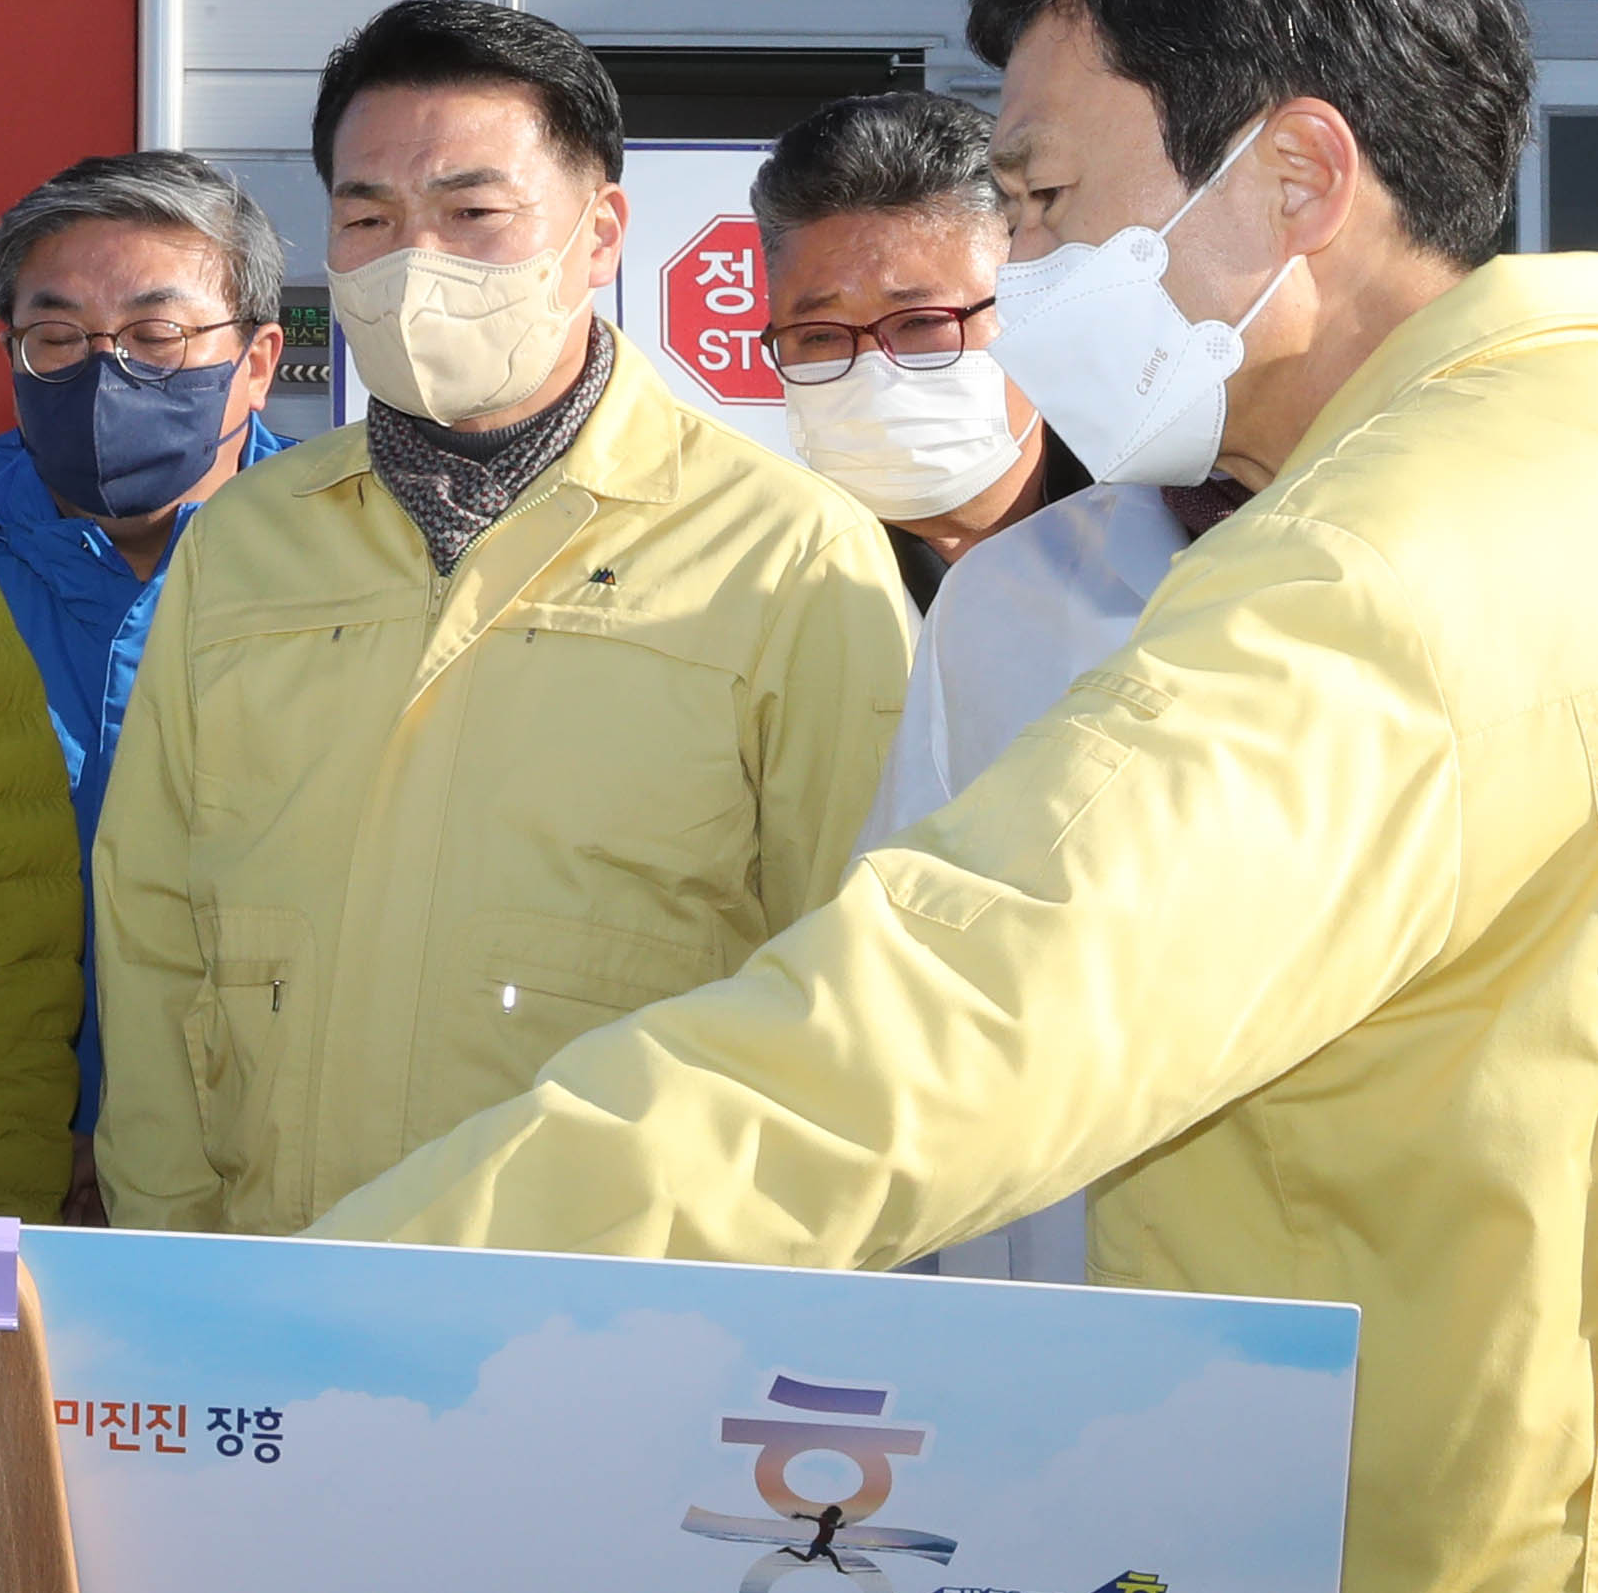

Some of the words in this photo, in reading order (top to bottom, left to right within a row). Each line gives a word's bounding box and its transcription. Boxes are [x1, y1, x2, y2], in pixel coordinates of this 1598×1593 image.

[695, 249, 769, 315] 정
[1136, 347, 1168, 396] Calling
[206, 1406, 284, 1464] 장흥
